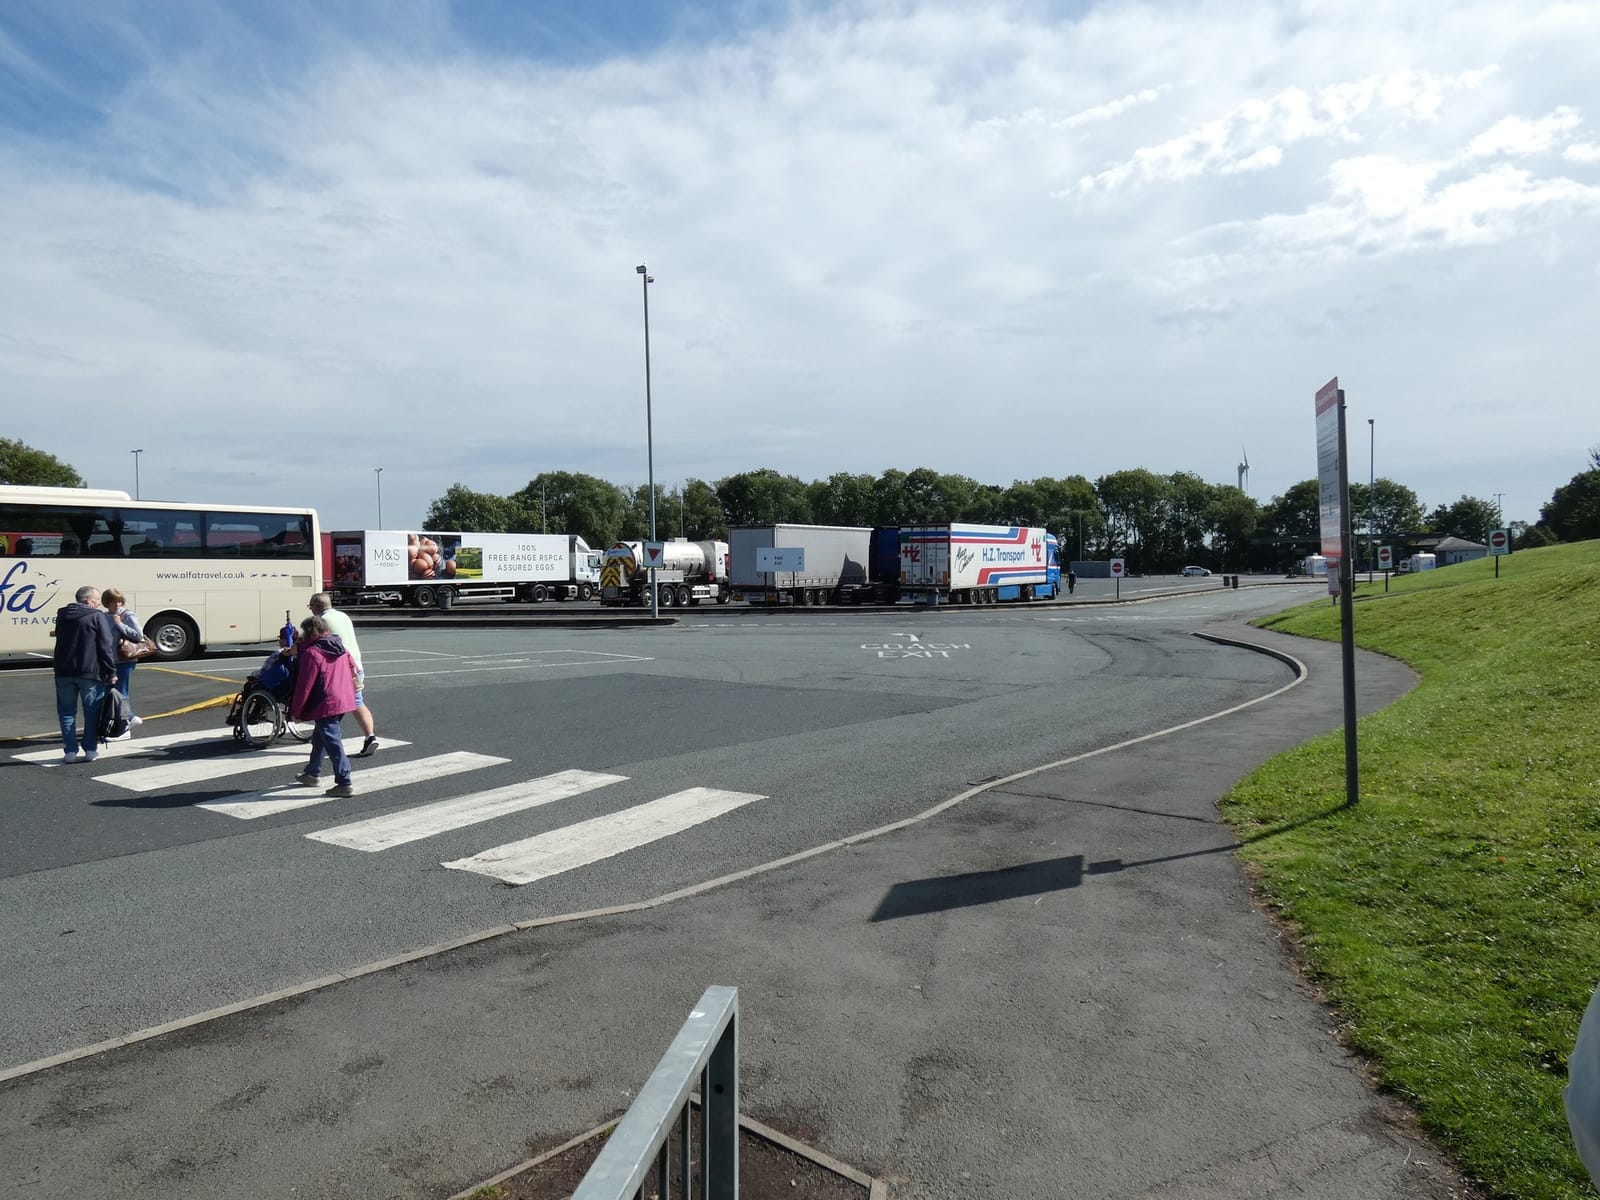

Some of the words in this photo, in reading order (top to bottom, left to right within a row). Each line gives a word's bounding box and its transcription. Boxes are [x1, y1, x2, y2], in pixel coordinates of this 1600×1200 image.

[517, 544, 537, 552] 100%
[374, 548, 400, 561] M&S
[488, 554, 508, 562] FREE
[510, 553, 537, 562] RANGE
[996, 547, 1026, 564] Transport
[497, 563, 533, 572] ASSURED
[535, 563, 555, 571] EGGS
[156, 571, 245, 579] www.alfatravel.co.uk
[878, 650, 950, 658] EXIT
